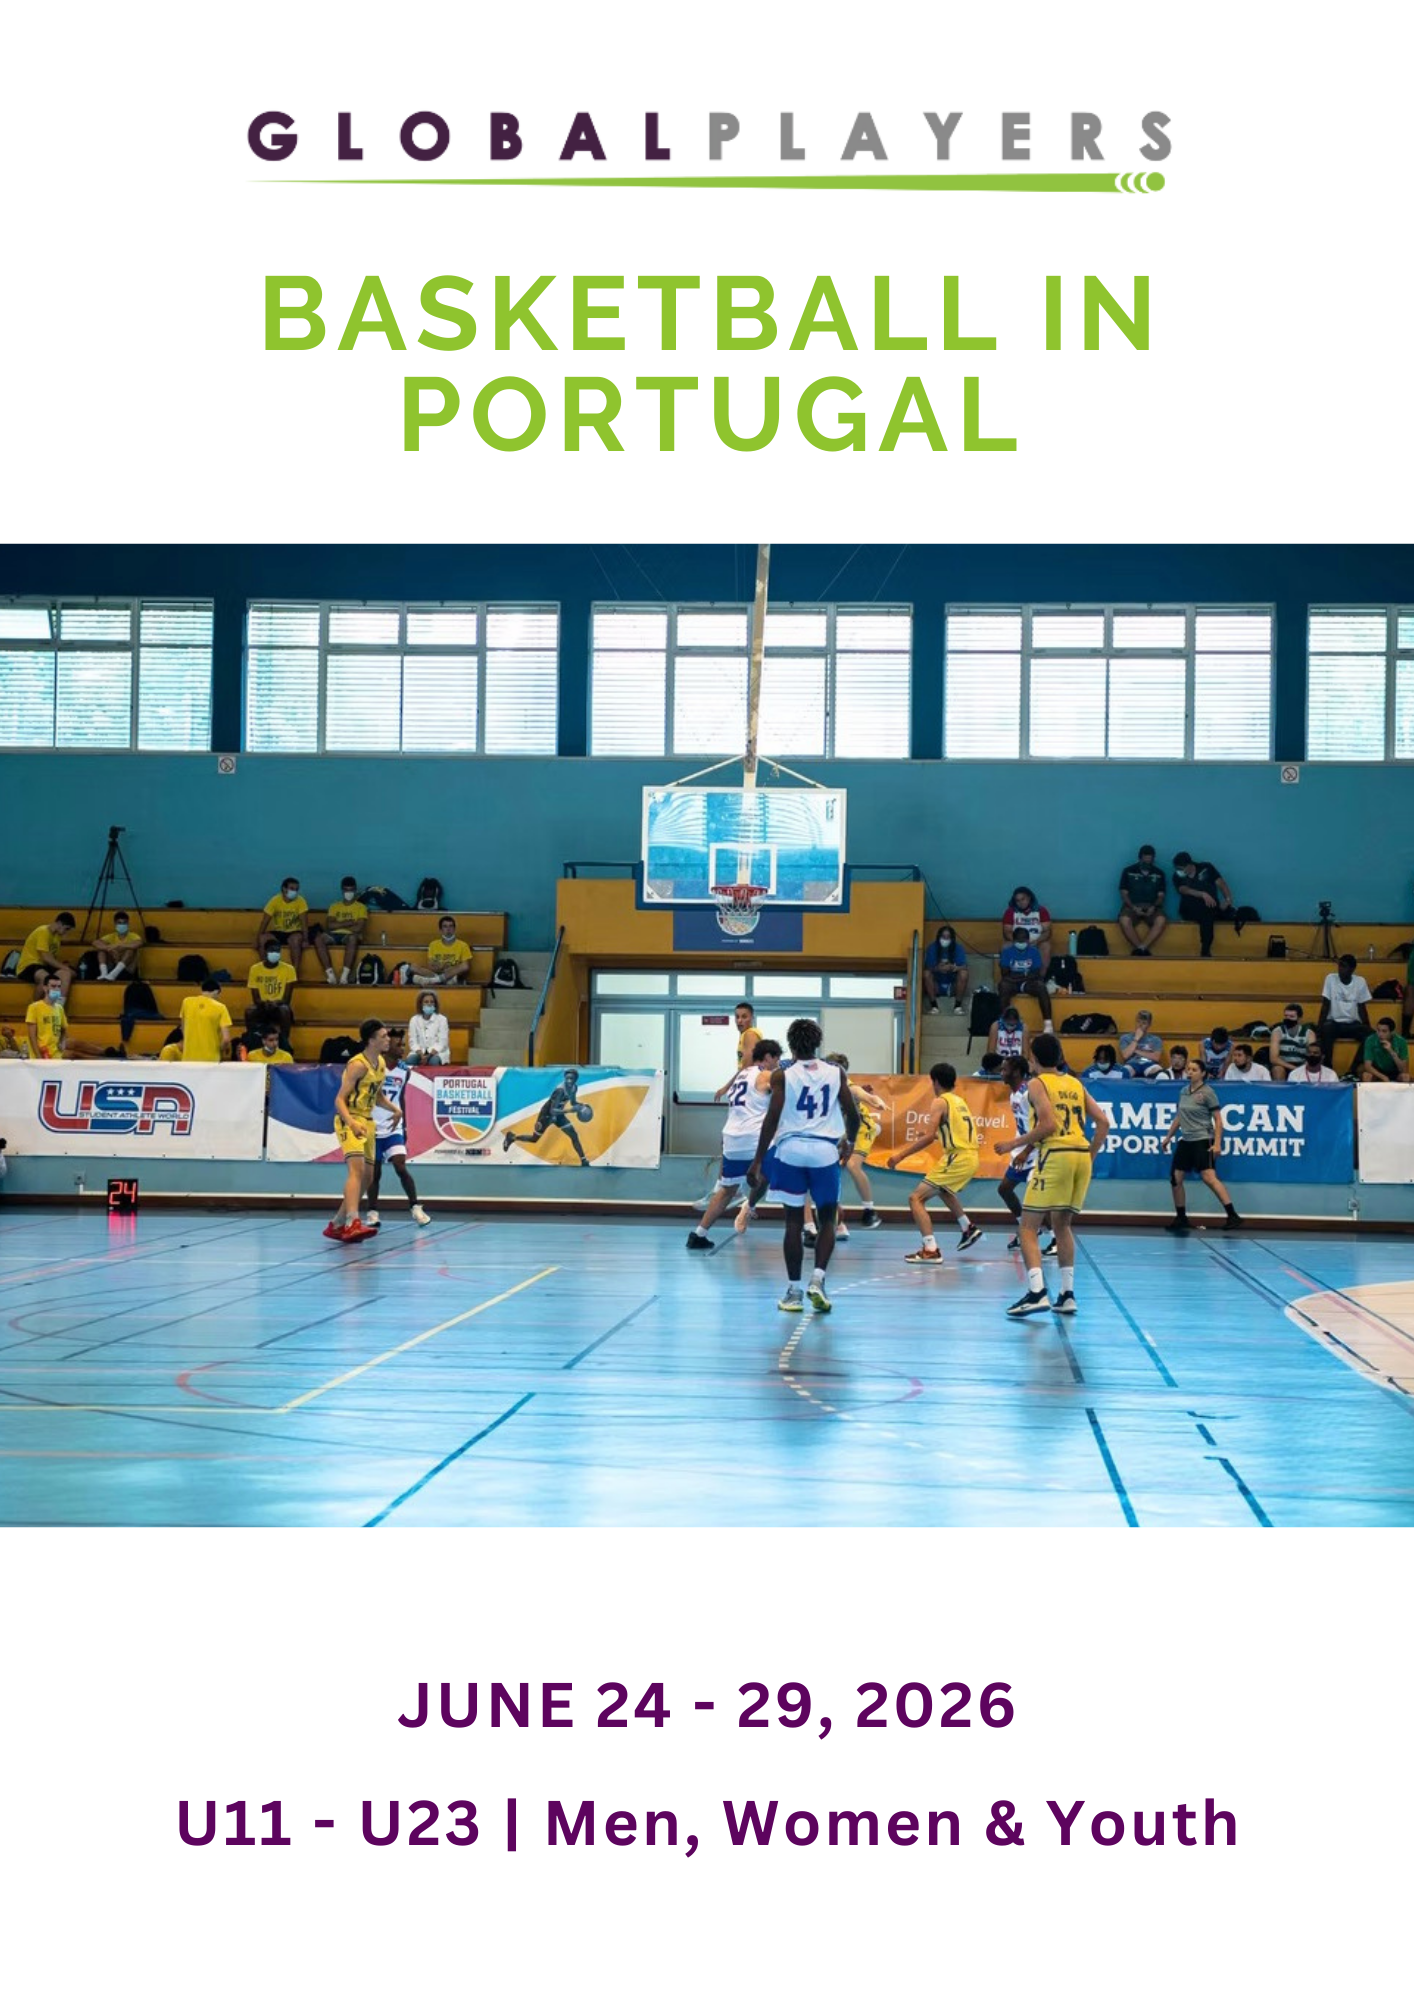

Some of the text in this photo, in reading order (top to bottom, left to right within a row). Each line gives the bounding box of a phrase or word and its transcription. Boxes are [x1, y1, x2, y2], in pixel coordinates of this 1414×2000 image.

[443, 1079, 487, 1089] PORTUGAL
[437, 1089, 493, 1099] BASKETBALL
[38, 1081, 195, 1136] USA
[796, 1084, 830, 1120] 41
[79, 1111, 190, 1120] STUDENT ATHLETE WORLD
[448, 1106, 480, 1114] FESTIVAL
[1091, 1102, 1306, 1133] AMECAN
[1032, 1177, 1045, 1192] 21
[109, 1181, 137, 1205] 24
